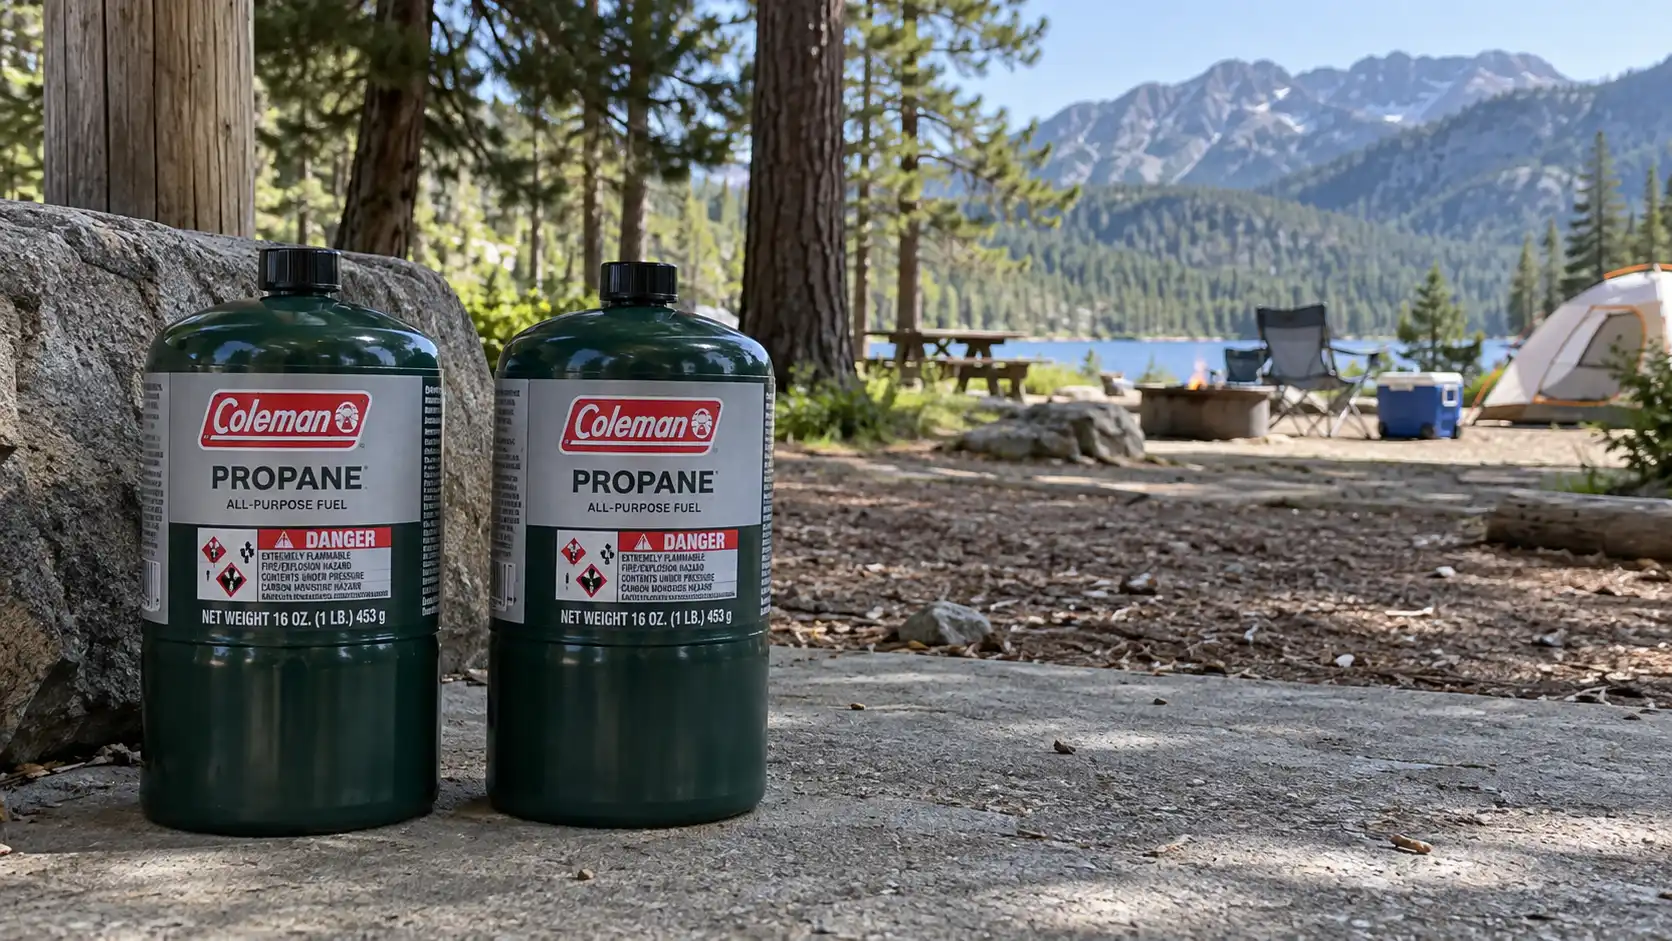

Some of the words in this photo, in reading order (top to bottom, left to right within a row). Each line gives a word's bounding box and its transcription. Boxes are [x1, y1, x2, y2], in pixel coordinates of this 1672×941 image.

[213, 397, 331, 434] Coleman
[574, 403, 688, 439] Coleman
[212, 465, 362, 490] PROPANE
[572, 469, 714, 494] PROPANE
[226, 499, 313, 510] ALL-PURPOSE
[317, 499, 348, 510] FUEL
[587, 503, 670, 513] ALL-PURPOSE
[674, 503, 701, 513] FUEL
[305, 530, 376, 548] DANGER
[663, 533, 725, 550] DANGER
[202, 609, 222, 624] NET
[225, 610, 270, 626] WEIGHT
[273, 612, 289, 626] 16
[292, 612, 312, 626] OZ.
[315, 611, 326, 628] (1
[330, 610, 353, 627] LB.)
[356, 609, 376, 623] 453
[379, 610, 386, 625] g
[560, 609, 581, 625] NET
[583, 610, 628, 626] WEIGHT
[631, 612, 646, 626] 16
[649, 611, 667, 626] OZ.
[670, 611, 681, 628] (1
[684, 610, 705, 627] LB.)
[707, 609, 724, 623] 453
[726, 610, 733, 625] g
